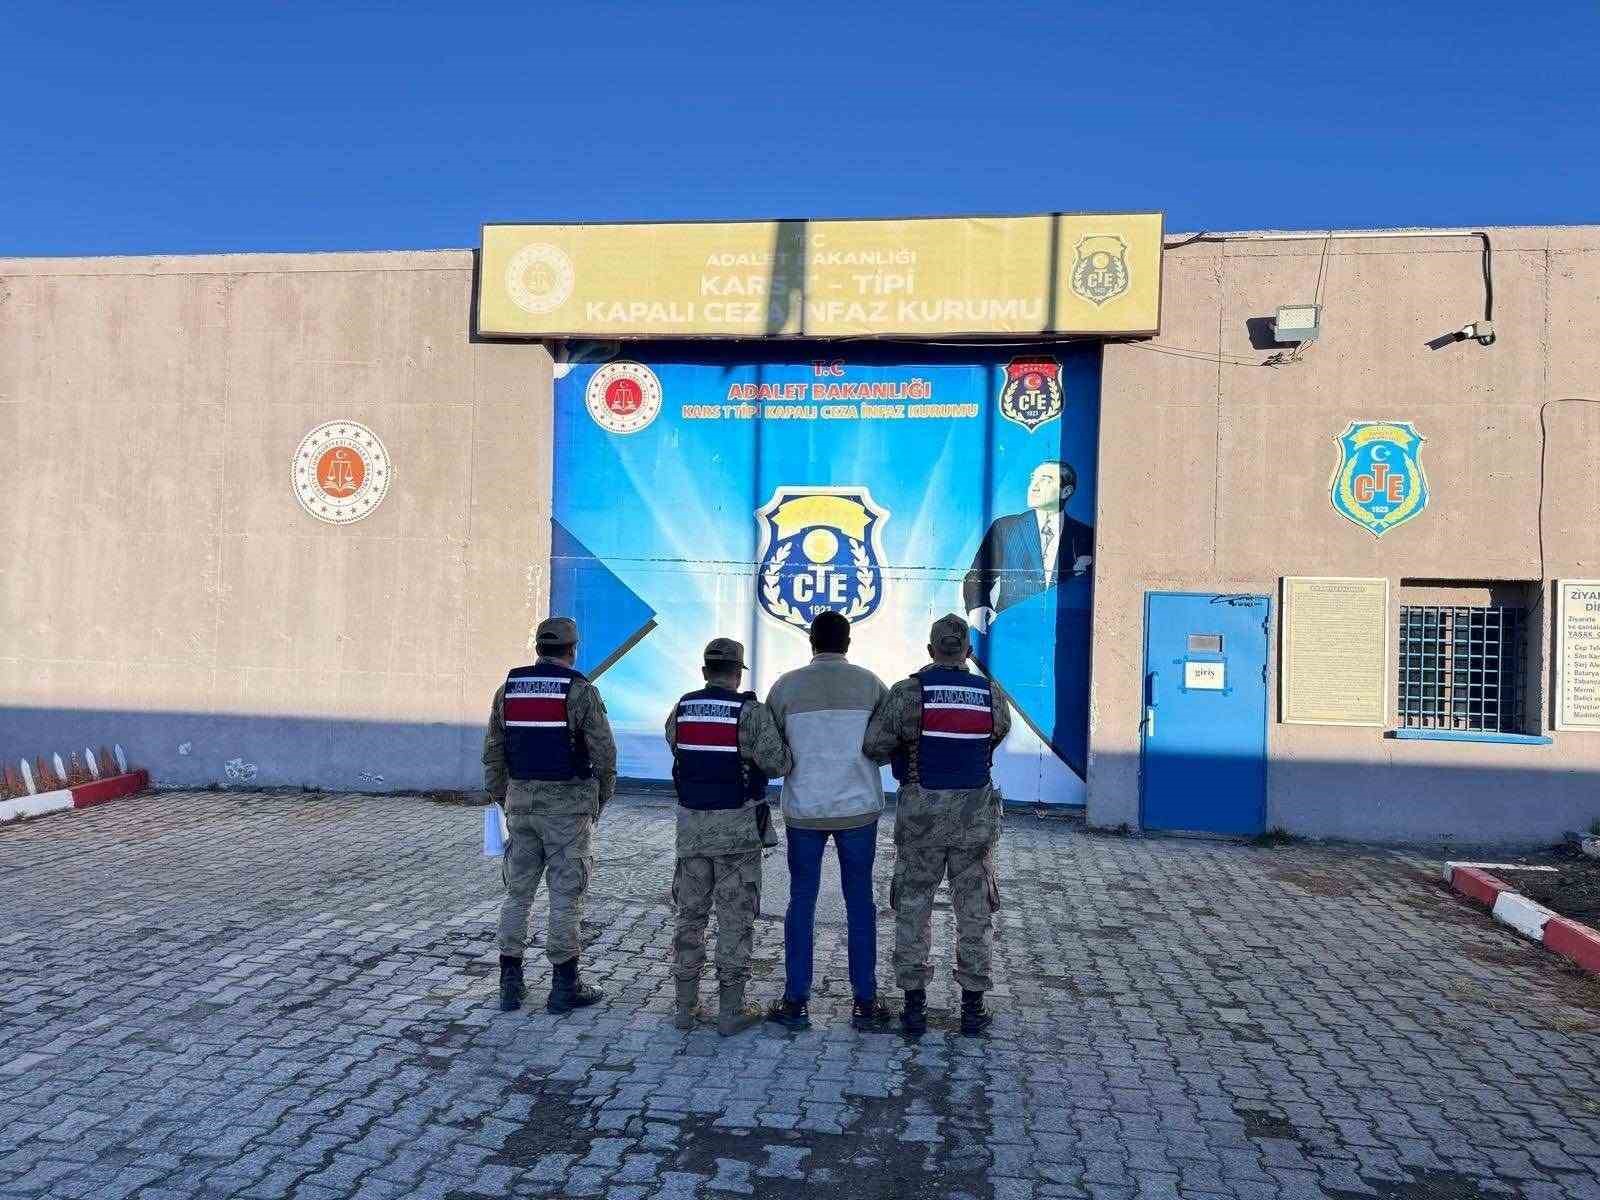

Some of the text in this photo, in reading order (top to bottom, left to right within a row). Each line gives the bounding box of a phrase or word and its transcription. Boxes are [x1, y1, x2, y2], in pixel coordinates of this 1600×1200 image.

[706, 253, 787, 267] ADALET
[700, 275, 787, 297] KARS
[852, 267, 915, 295] TİPİ
[1087, 269, 1114, 288] CTE
[585, 300, 695, 322] KAPALI
[703, 300, 786, 322] CEZA
[898, 298, 1042, 321] KURUMU
[728, 378, 932, 400] ADALET BAKANLIĞI
[1019, 389, 1047, 411] CTE
[681, 404, 721, 419] KARS
[764, 404, 818, 419] KAPALI
[820, 404, 858, 419] CEZA
[860, 401, 905, 419] İNFAZ
[907, 403, 979, 418] KURUMU
[1354, 463, 1405, 503] CTE
[793, 563, 848, 603] CTE
[930, 689, 986, 706] JANDARMA
